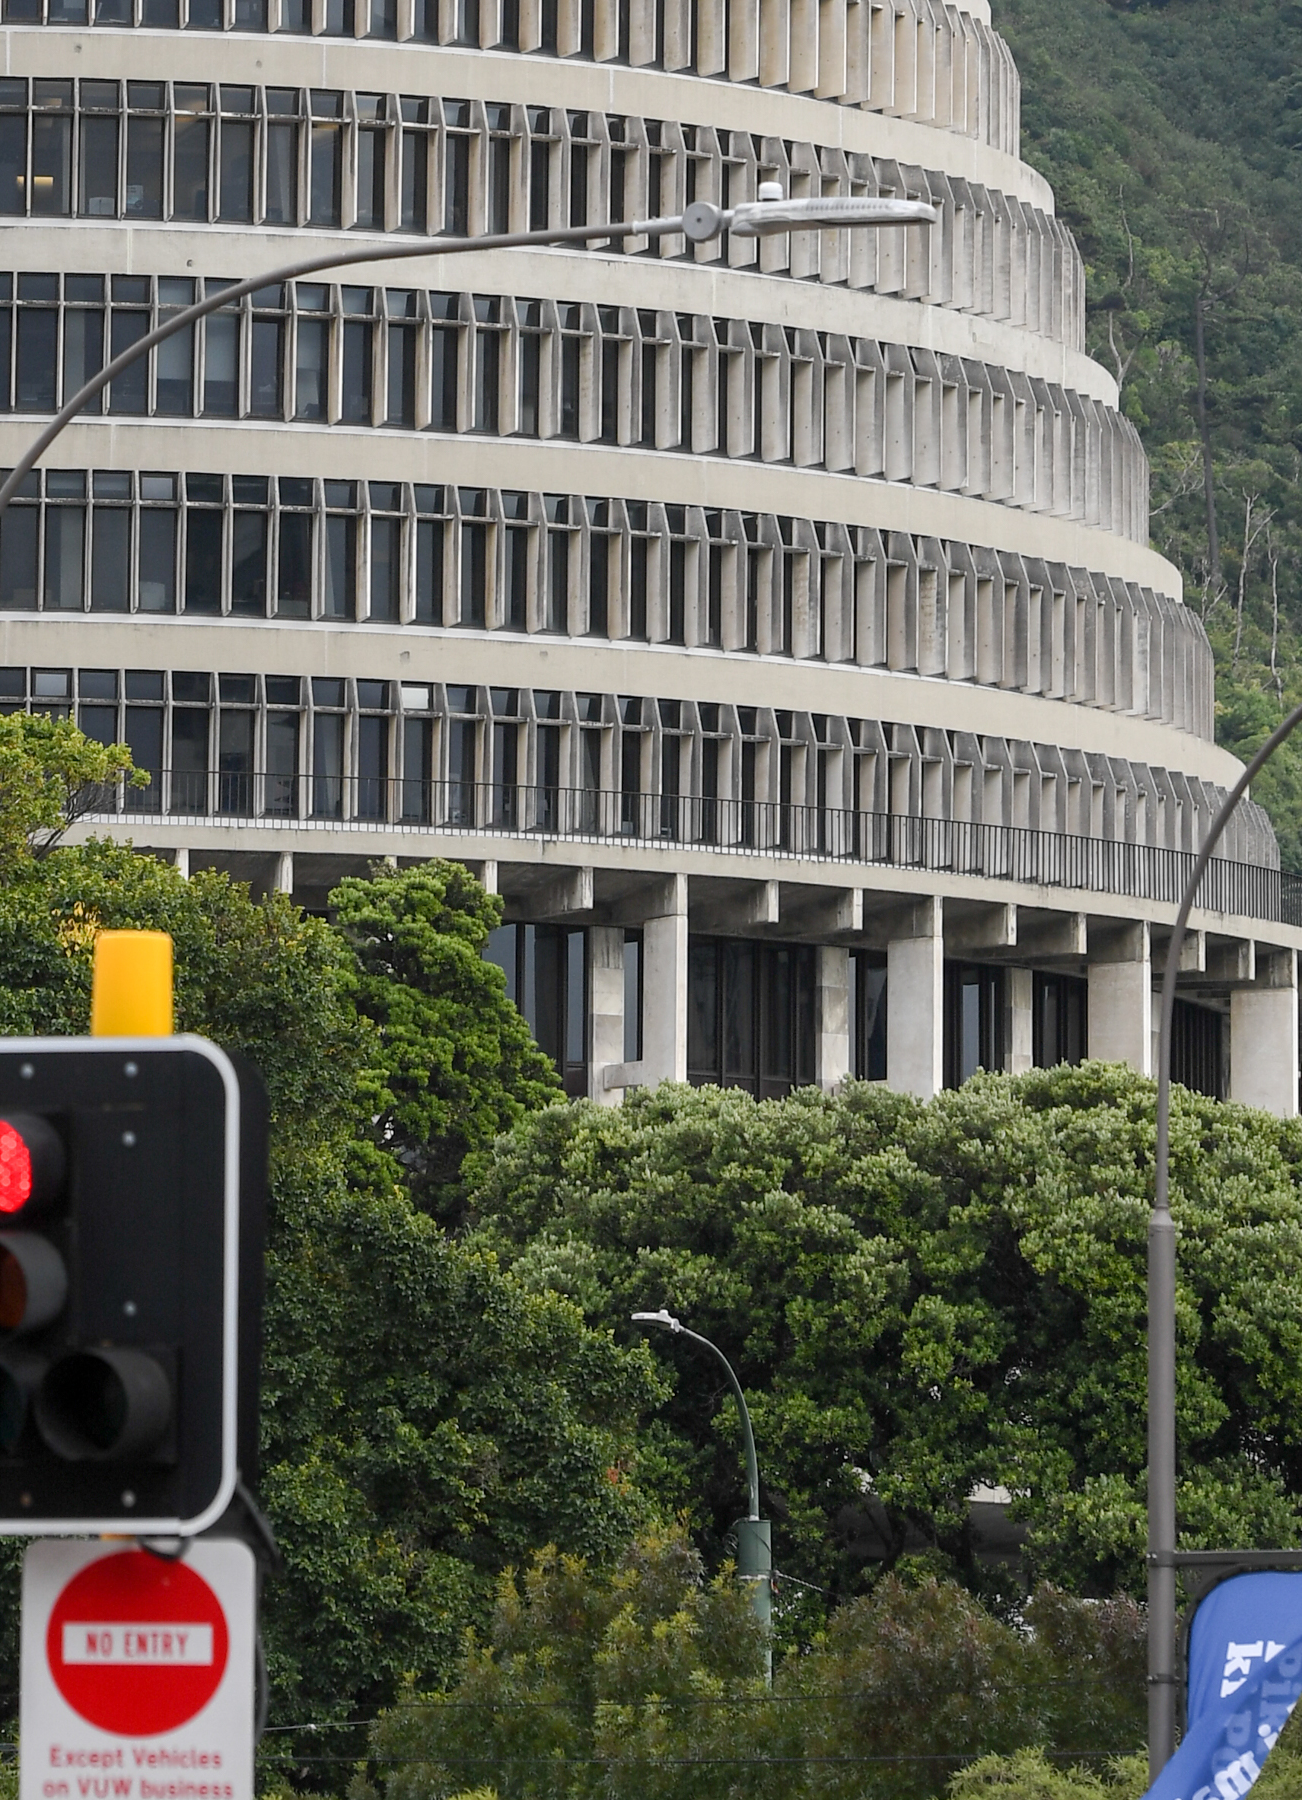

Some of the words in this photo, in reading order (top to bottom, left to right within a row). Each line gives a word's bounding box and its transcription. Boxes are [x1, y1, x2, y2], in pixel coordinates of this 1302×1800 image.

[85, 1631, 113, 1656] NO
[124, 1631, 188, 1657] ENTRY
[50, 1746, 123, 1769] Except
[132, 1747, 222, 1768] Vehicles
[43, 1781, 69, 1797] on
[78, 1778, 132, 1797] VUW
[141, 1779, 233, 1798] business
